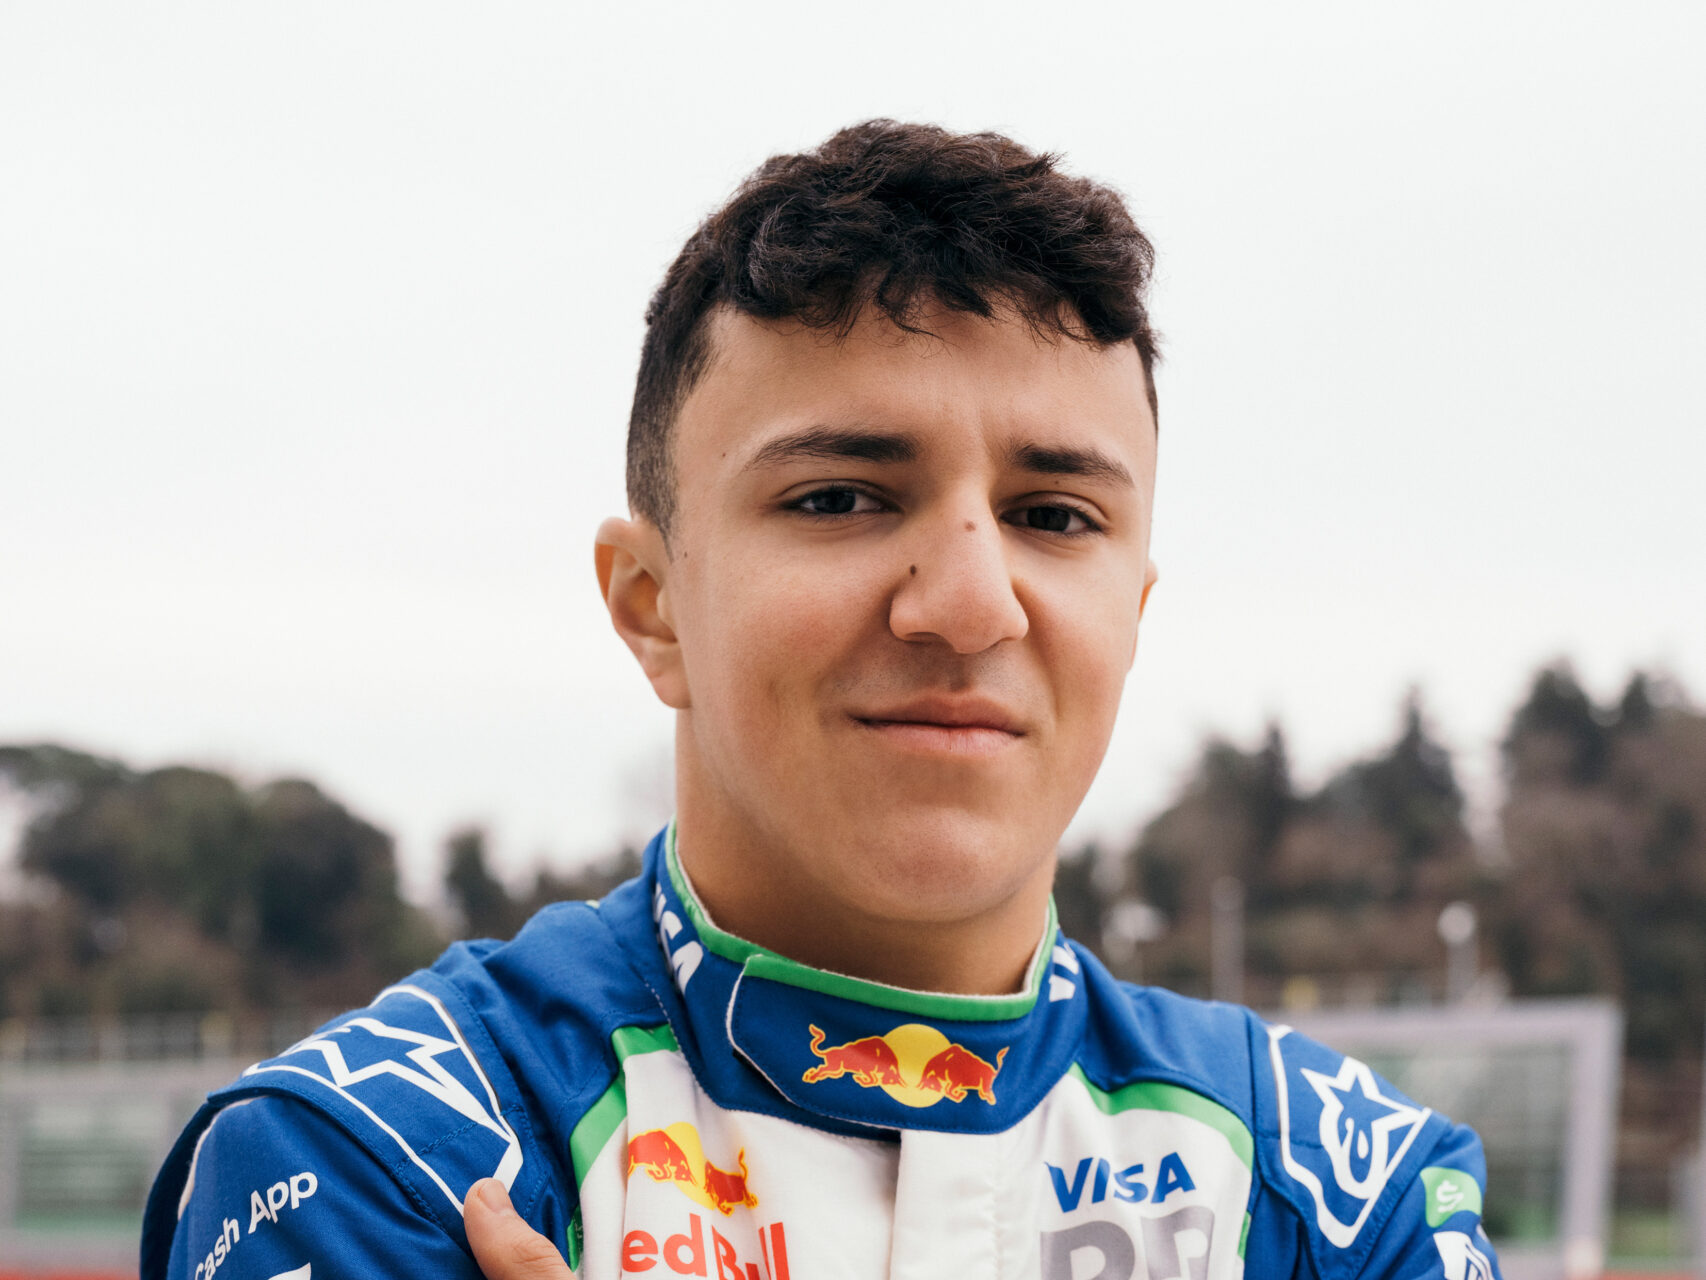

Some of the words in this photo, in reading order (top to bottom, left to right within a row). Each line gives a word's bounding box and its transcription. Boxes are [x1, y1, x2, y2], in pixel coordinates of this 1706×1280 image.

[247, 1171, 319, 1235] App
[1044, 1151, 1197, 1214] VISA
[621, 1212, 708, 1278] ed
